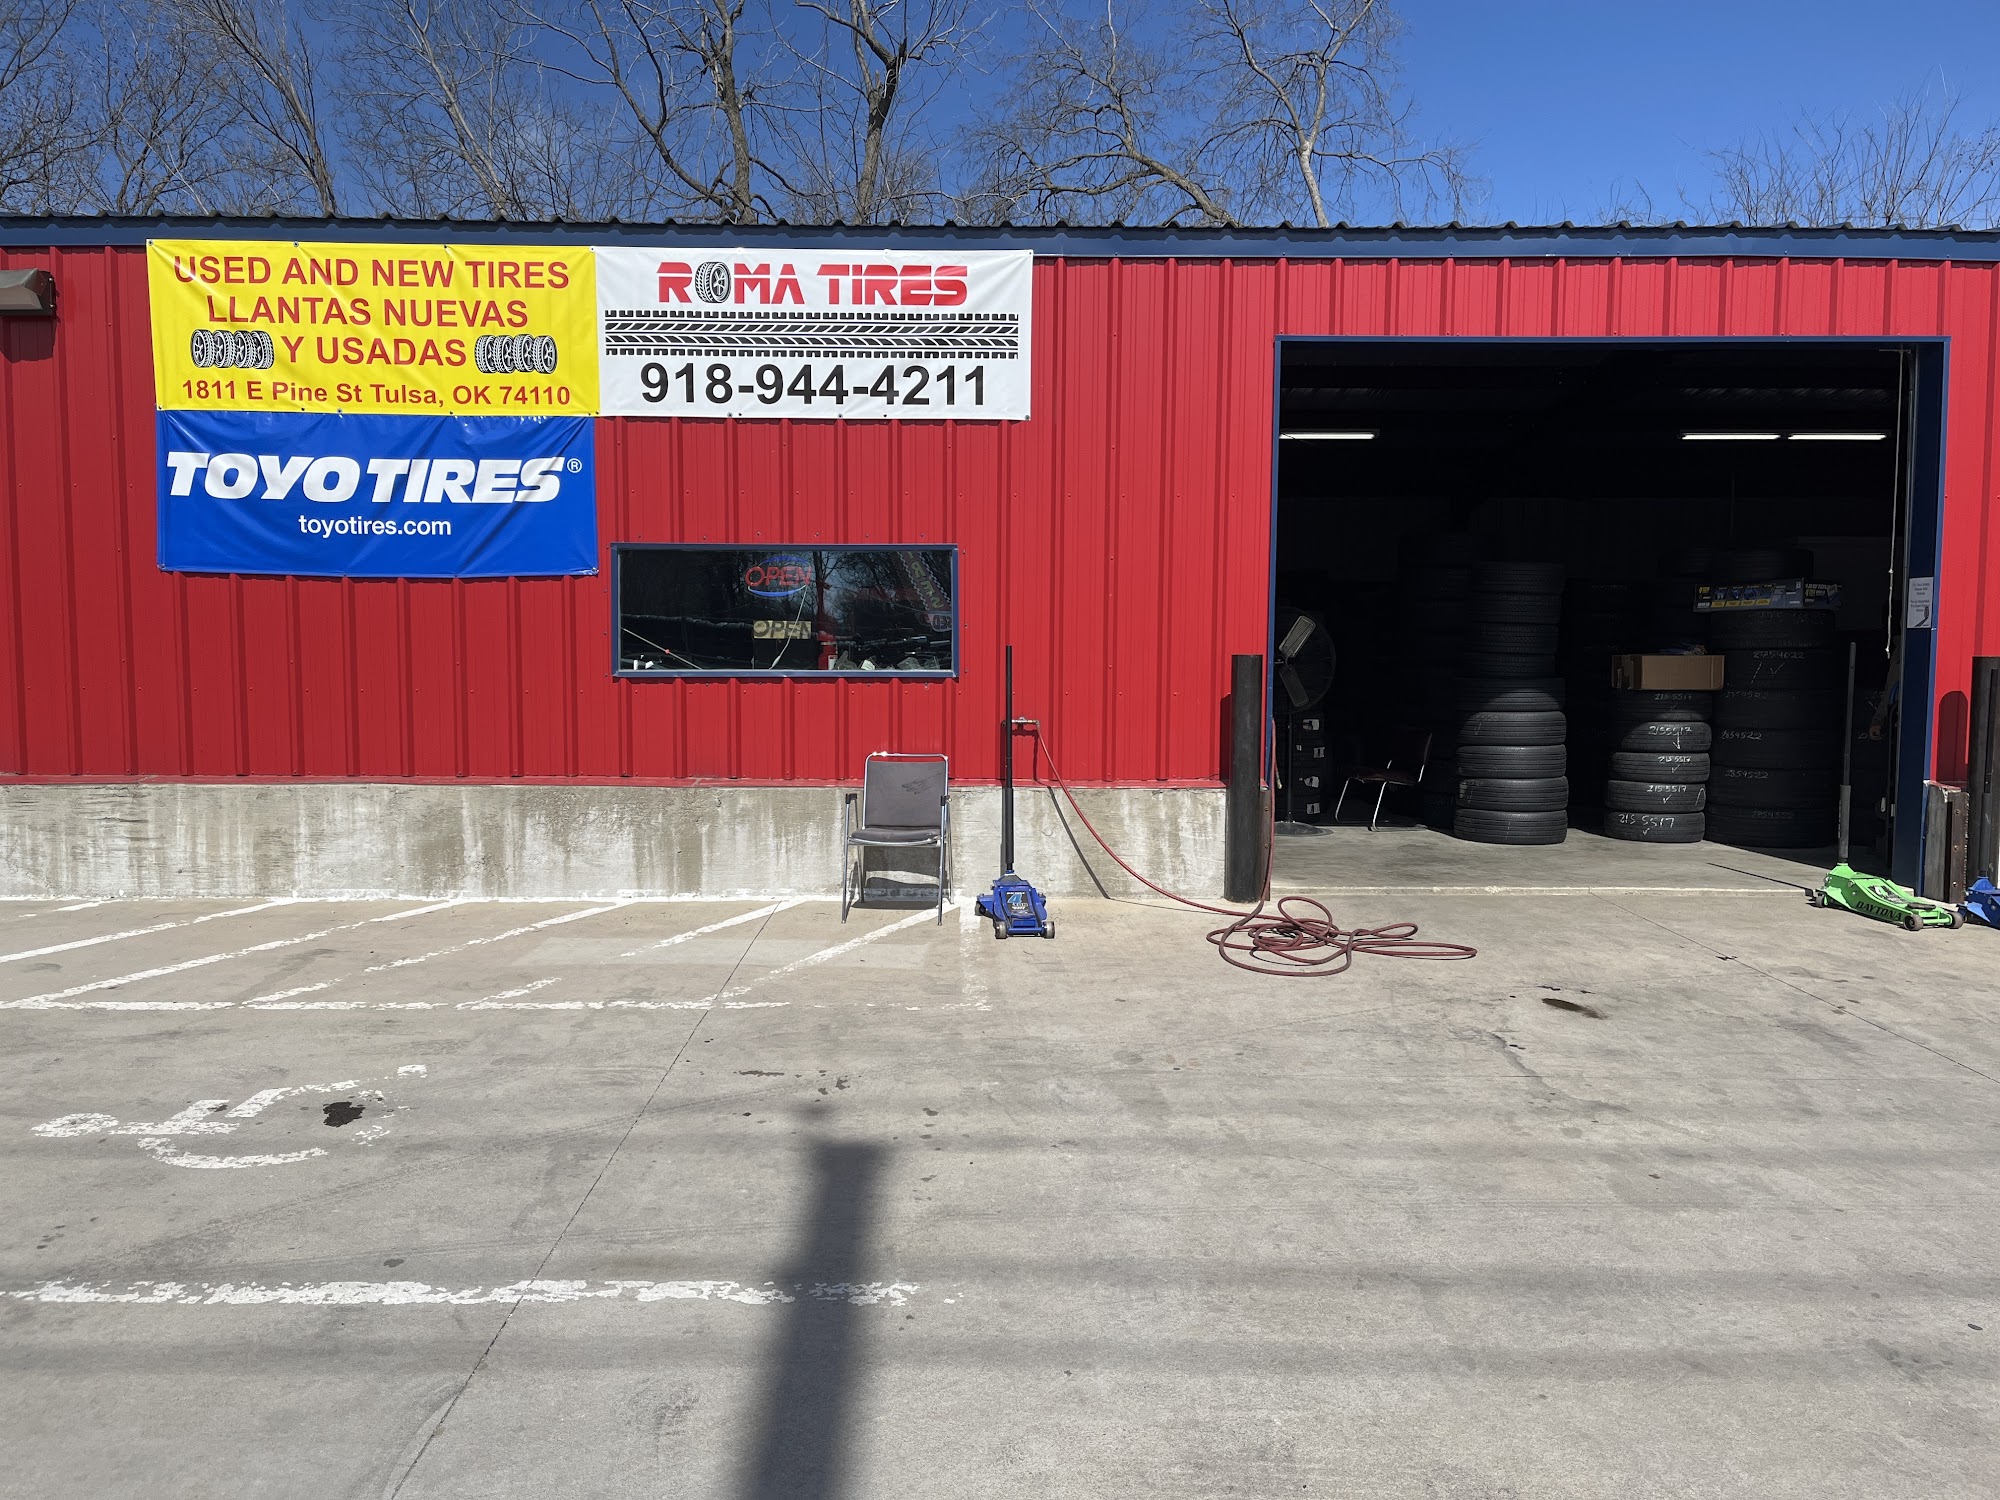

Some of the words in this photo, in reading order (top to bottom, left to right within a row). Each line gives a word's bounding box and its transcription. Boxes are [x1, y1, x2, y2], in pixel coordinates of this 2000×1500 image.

[174, 256, 271, 284] USED
[282, 258, 359, 286] AND
[372, 260, 454, 288] NEW
[465, 261, 570, 289] TIRES
[657, 261, 805, 305] ROMA
[816, 264, 968, 306] TIRES
[207, 295, 371, 326] LLANTAS
[384, 299, 528, 328] NUEVAS
[281, 336, 303, 362] Y
[316, 337, 467, 367] USADAS
[182, 380, 236, 400] 1811
[247, 381, 263, 400] E
[272, 382, 328, 402] Pine
[336, 384, 363, 403] St
[370, 384, 444, 408] Tulsa,
[453, 386, 491, 405] OK
[500, 386, 570, 405] 74110
[640, 362, 985, 406] 918-944-4211
[166, 451, 361, 503] TOYO
[298, 515, 452, 539] toyotires.com
[744, 565, 813, 587] OPEN
[753, 620, 811, 639] OPEN
[1856, 901, 1902, 921] DAYTONA
